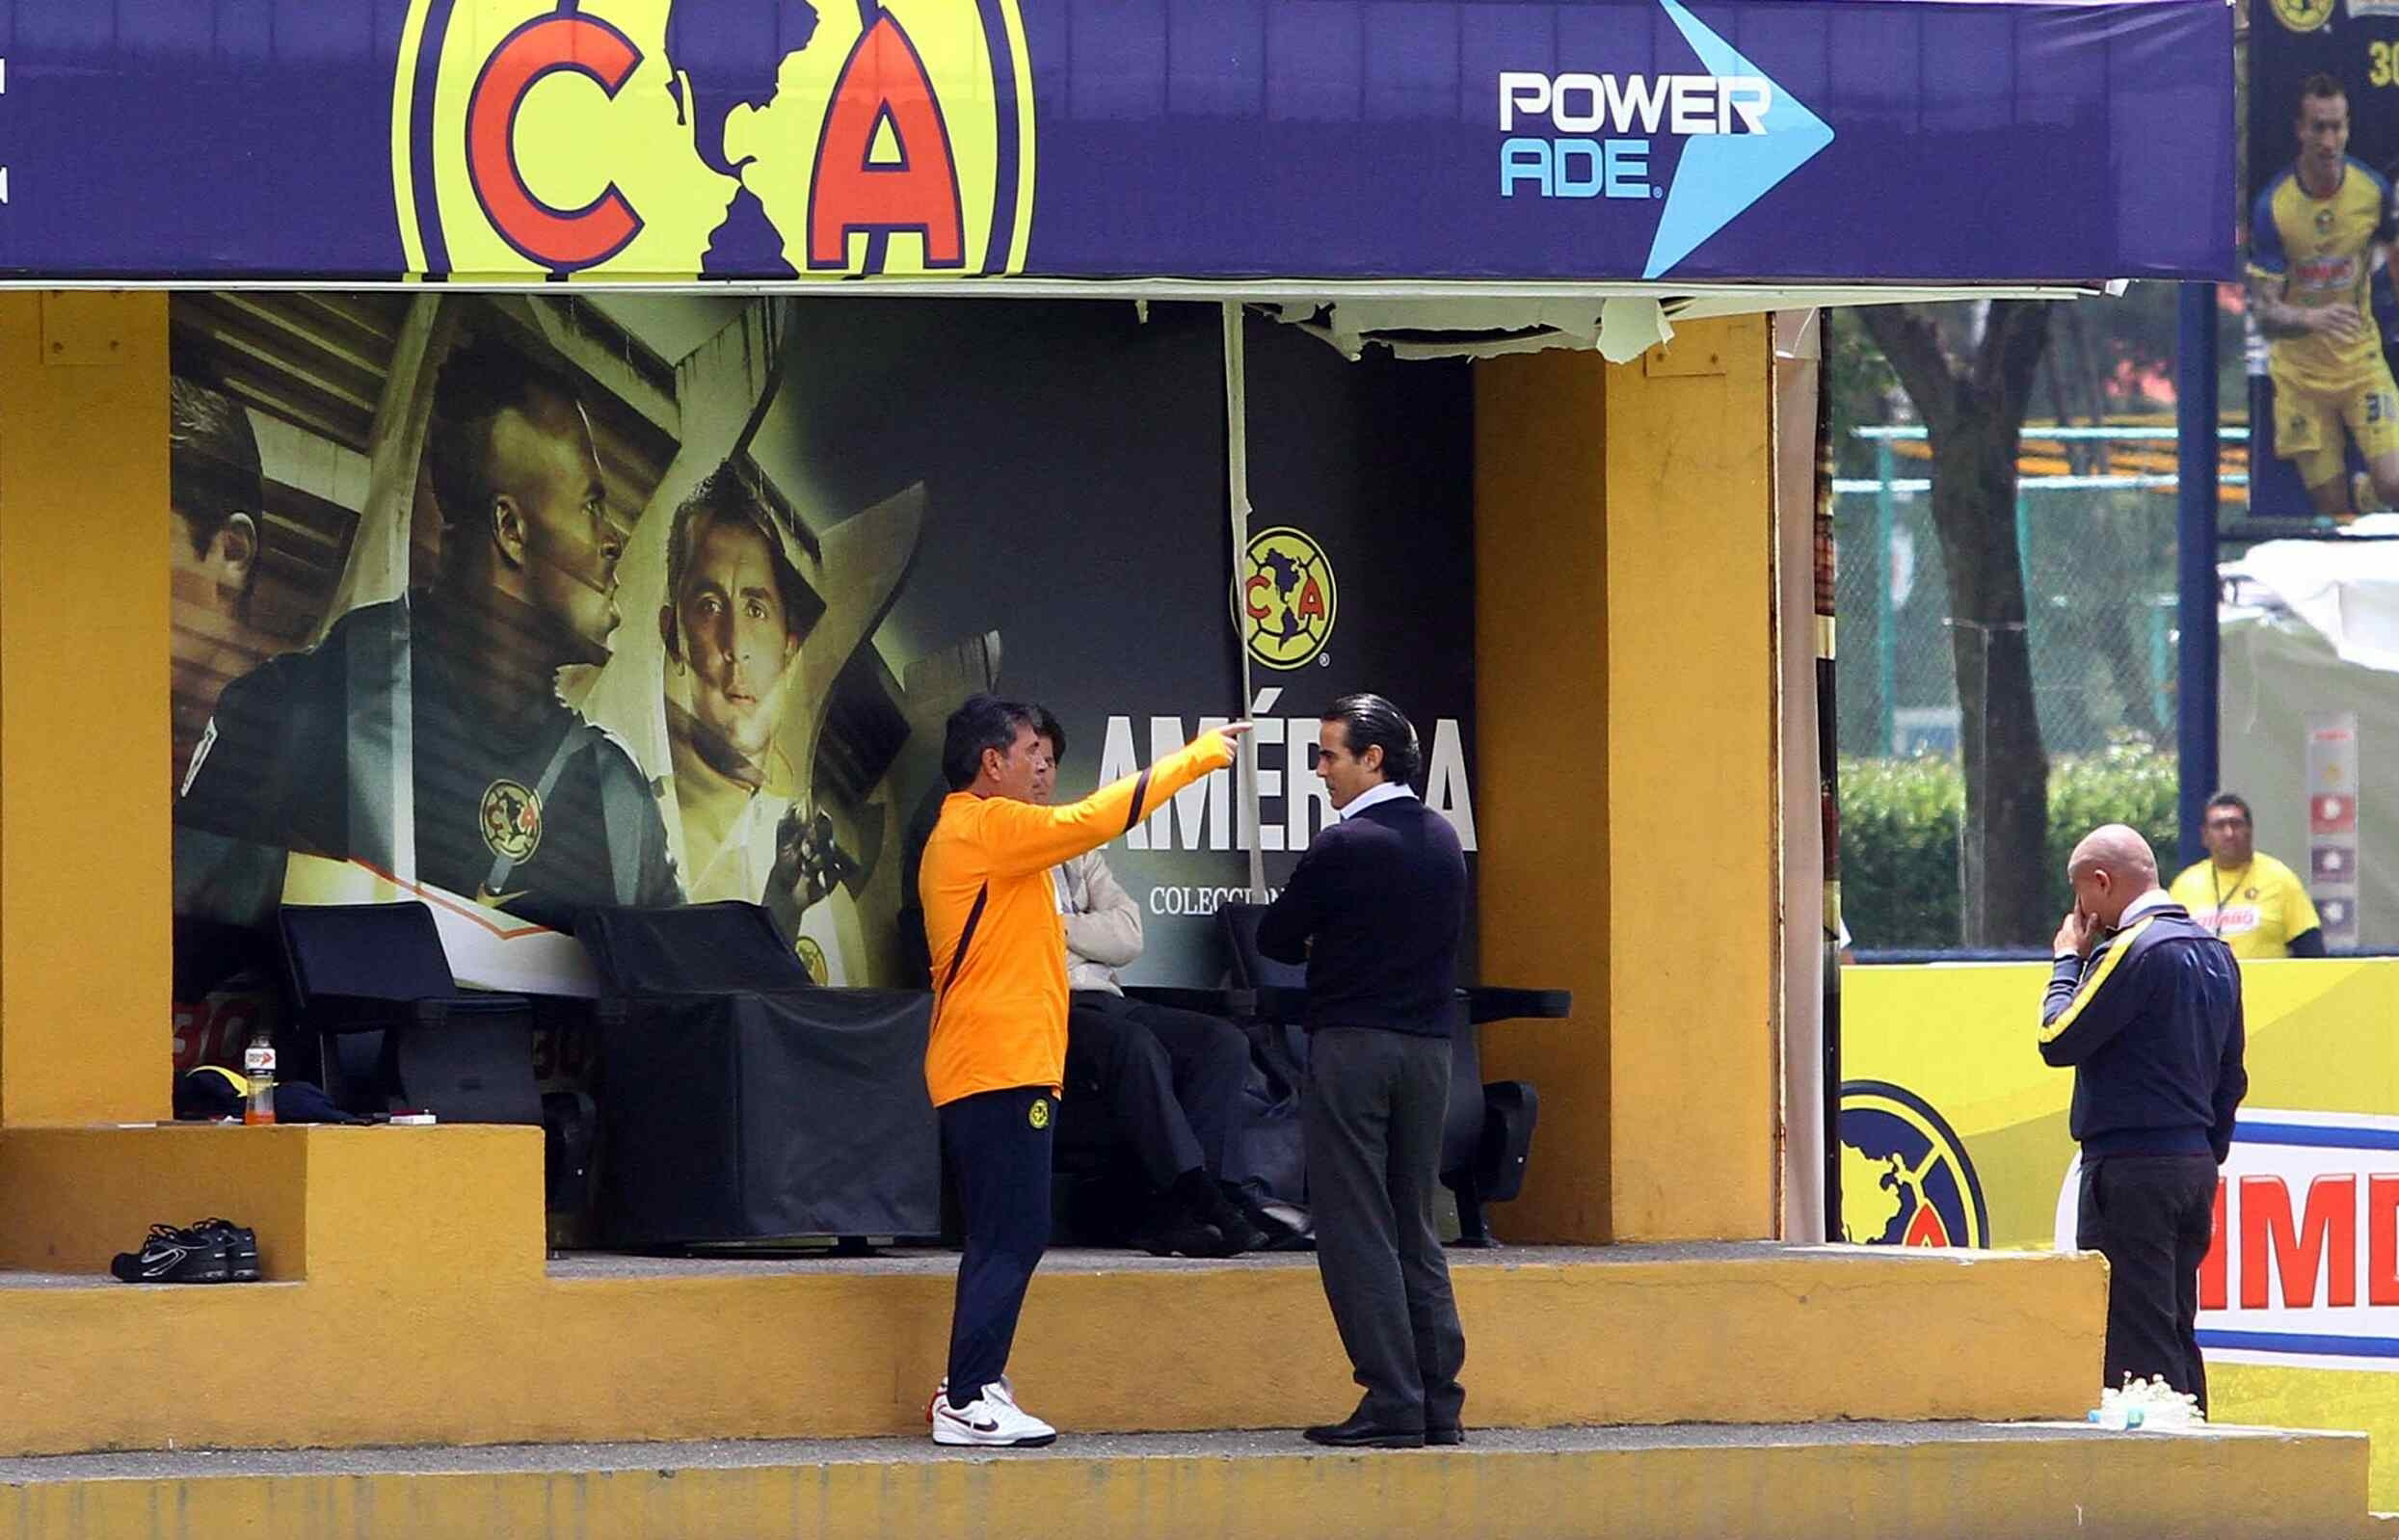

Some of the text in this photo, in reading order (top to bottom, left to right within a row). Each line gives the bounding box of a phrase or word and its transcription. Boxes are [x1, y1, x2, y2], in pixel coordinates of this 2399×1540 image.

[1499, 71, 1773, 136] POWER
[1500, 138, 1651, 199] ADE
[1095, 687, 1478, 853] AMÉRA
